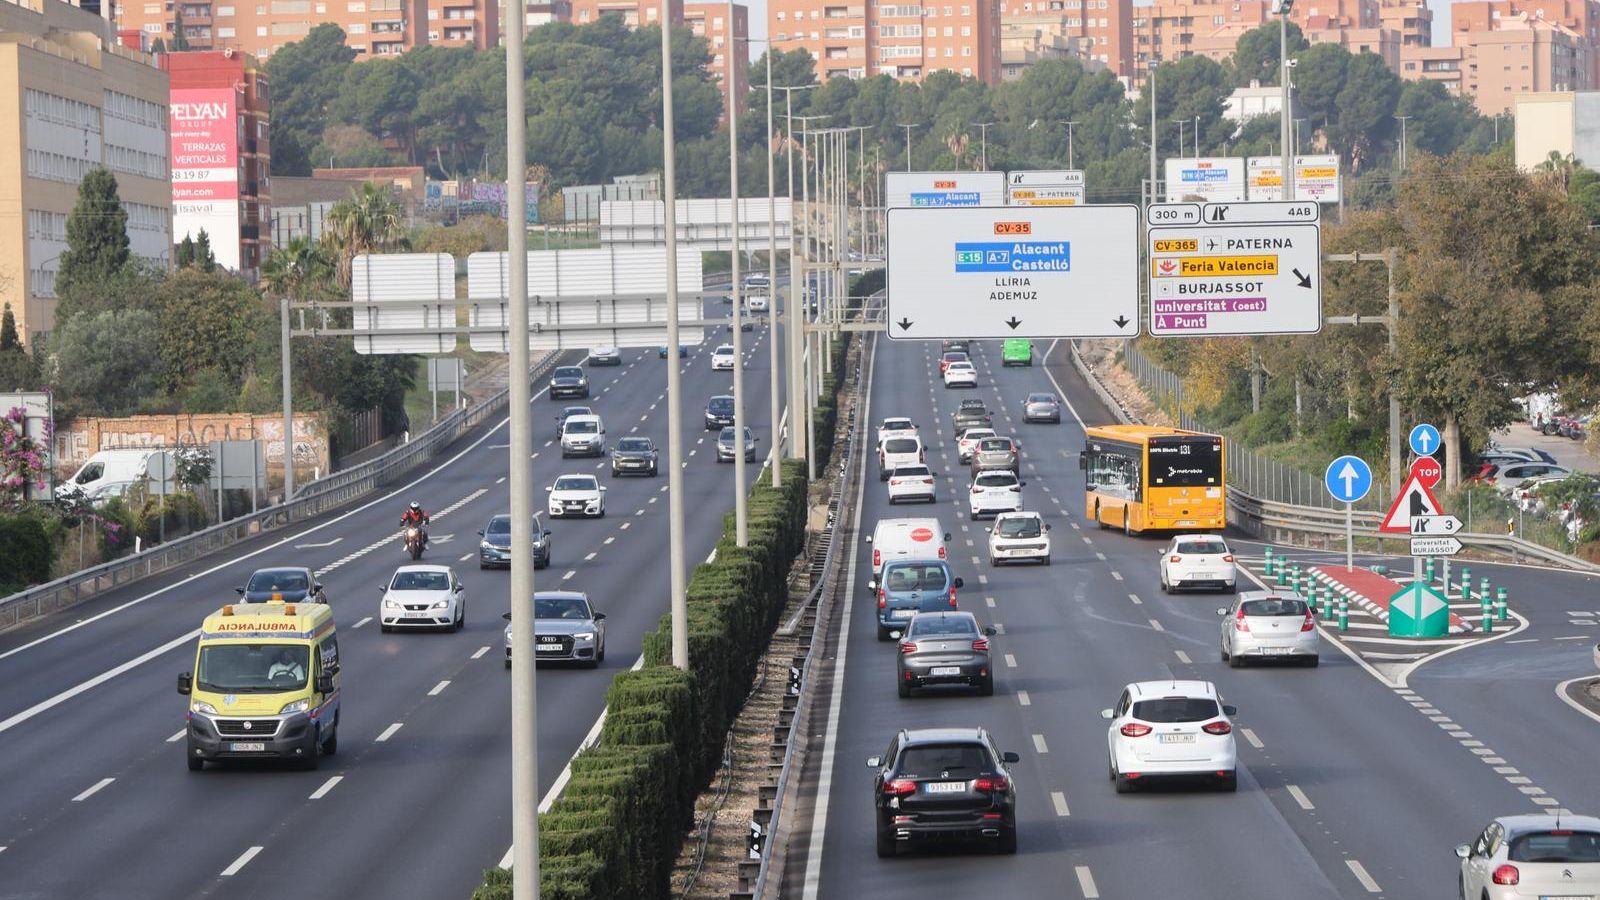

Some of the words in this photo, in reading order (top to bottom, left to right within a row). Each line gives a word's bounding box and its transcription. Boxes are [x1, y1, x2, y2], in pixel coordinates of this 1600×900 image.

[182, 142, 226, 152] TERRAZAS
[175, 154, 227, 164] VERTICALES
[184, 171, 195, 180] 19
[197, 170, 209, 180] 87
[172, 187, 214, 198] lyan.com
[1155, 211, 1177, 219] 300
[1288, 207, 1311, 216] 4AB
[995, 224, 1029, 233] CV-35
[1013, 244, 1065, 254] Alacant
[1155, 241, 1196, 250] CV-365
[1227, 238, 1293, 249] PATERNA
[957, 252, 981, 262] E-15
[989, 252, 1008, 262] A-7
[1012, 259, 1068, 271] Castelló
[1182, 262, 1214, 272] Feria
[1218, 260, 1275, 271] Valencia
[995, 276, 1031, 287] LLÍRIA
[1178, 282, 1264, 294] BURJASSOT
[989, 291, 1038, 300] ADEMUZ
[1156, 300, 1227, 312] universitat
[1232, 302, 1265, 311] (oest)
[1157, 315, 1167, 328] À
[1174, 317, 1206, 328] Punt
[1445, 520, 1453, 530] 3
